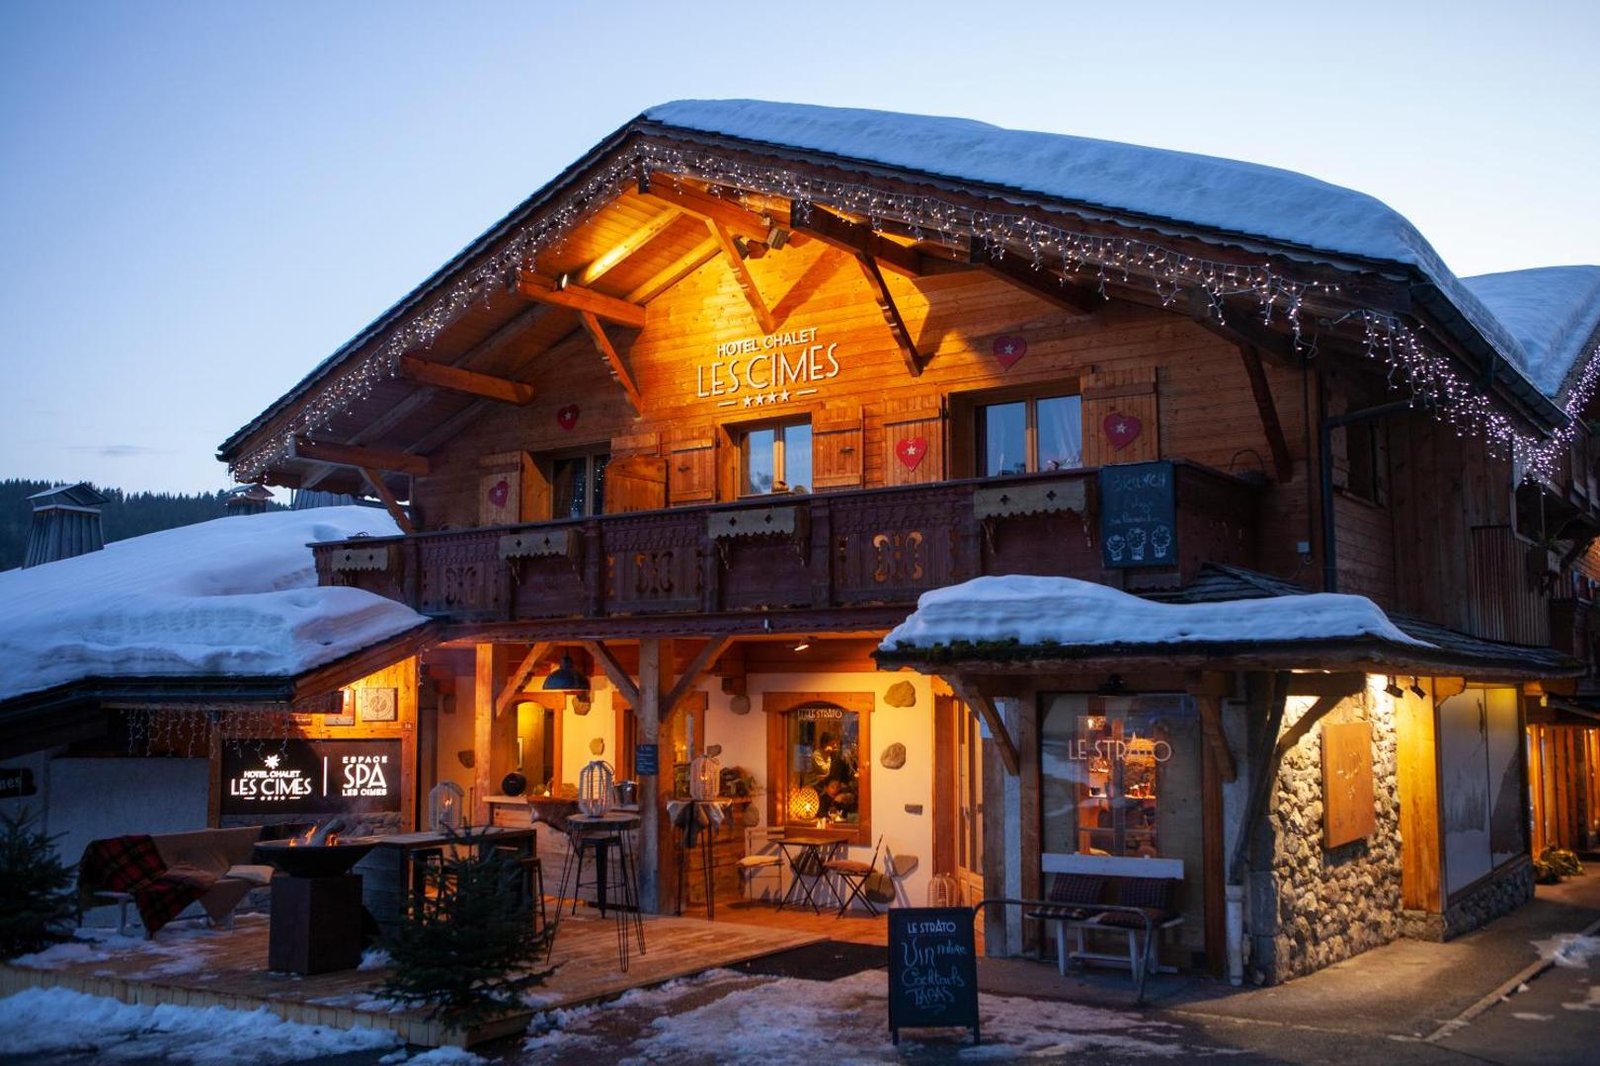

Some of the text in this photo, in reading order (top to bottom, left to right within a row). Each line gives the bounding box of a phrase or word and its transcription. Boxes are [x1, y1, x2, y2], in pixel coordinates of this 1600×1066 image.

[718, 327, 818, 357] HOTEL CHALET
[697, 342, 840, 398] LES CIMES
[816, 708, 843, 719] STRATO
[1069, 740, 1087, 760] LE
[342, 756, 388, 764] ESPACE
[243, 770, 301, 779] HOTEL CHALET
[343, 763, 387, 789] SPA
[231, 777, 312, 796] LES CIMES
[342, 787, 388, 797] LES CIMES
[907, 919, 957, 934] LE STRATO
[901, 936, 935, 968] Vin
